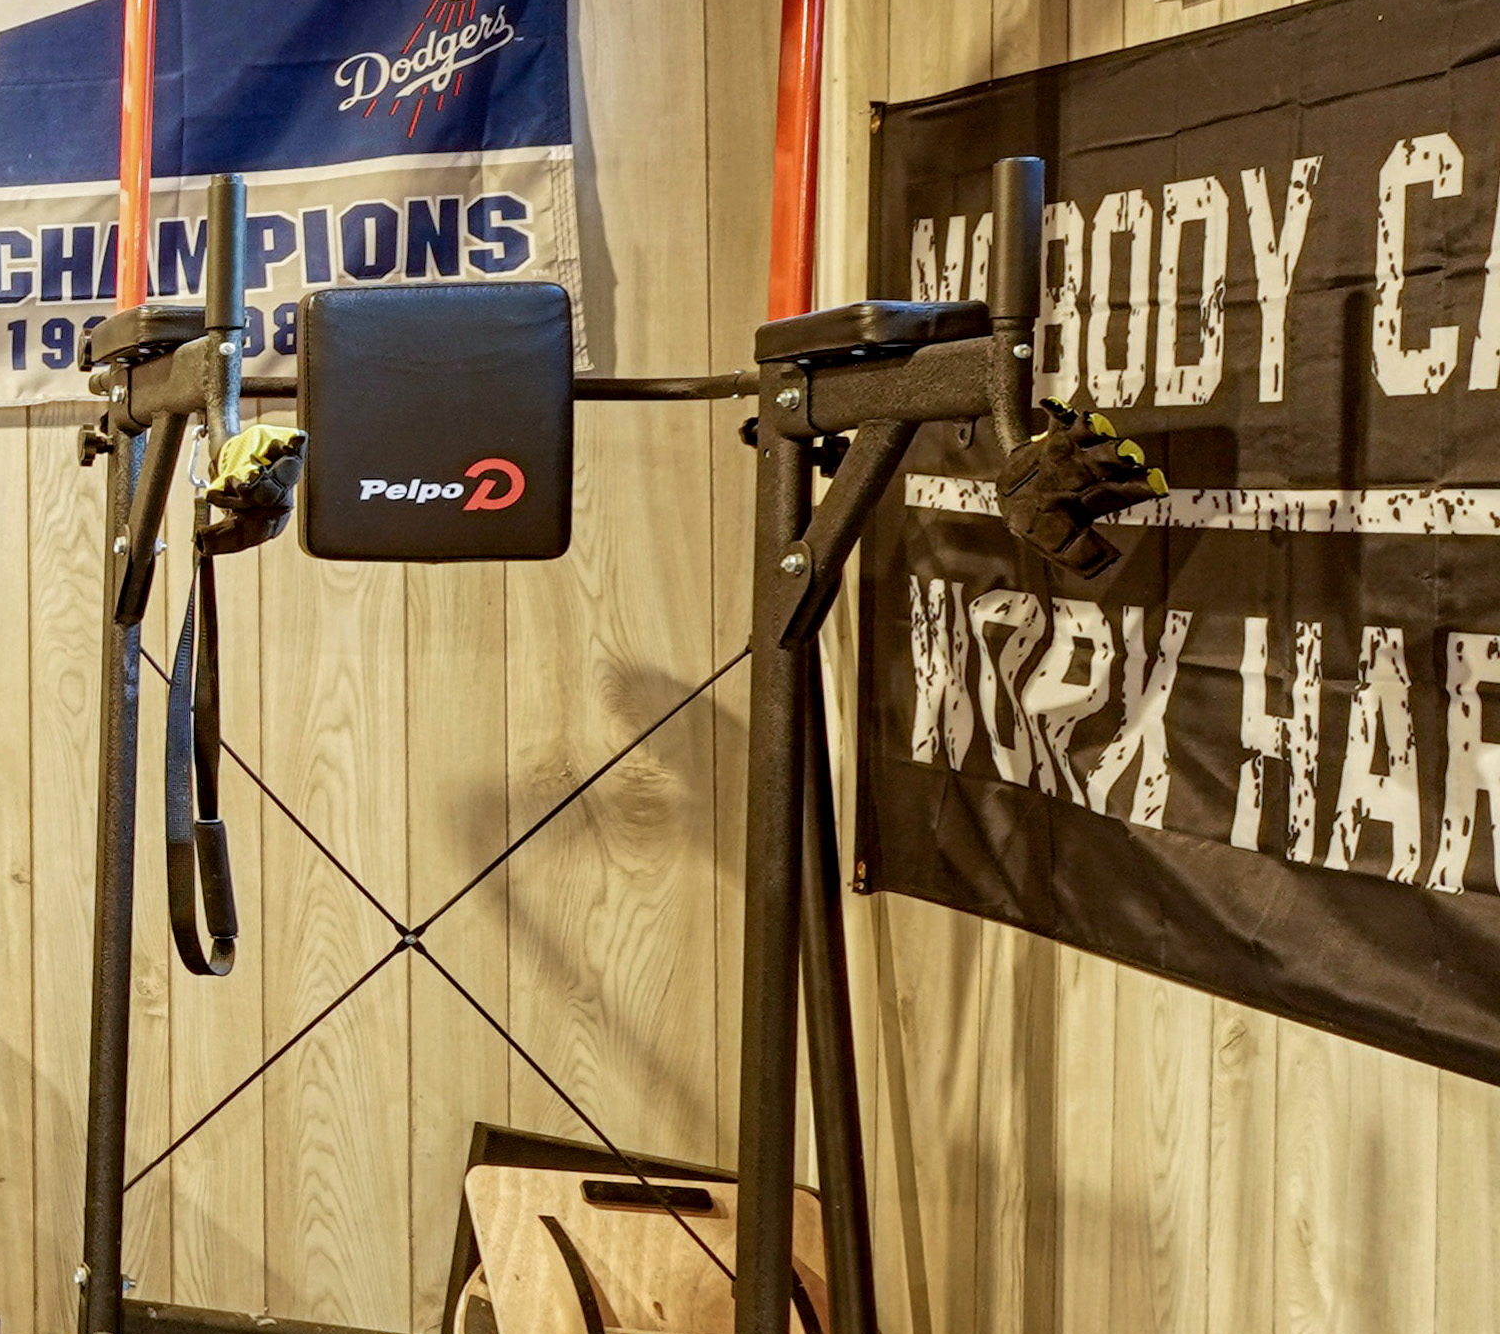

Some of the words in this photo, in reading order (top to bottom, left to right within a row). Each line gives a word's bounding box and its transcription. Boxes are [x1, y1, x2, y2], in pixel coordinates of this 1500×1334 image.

[334, 5, 515, 111] Dodgers
[359, 478, 465, 505] Pelpo
[909, 574, 1194, 830] WORK
